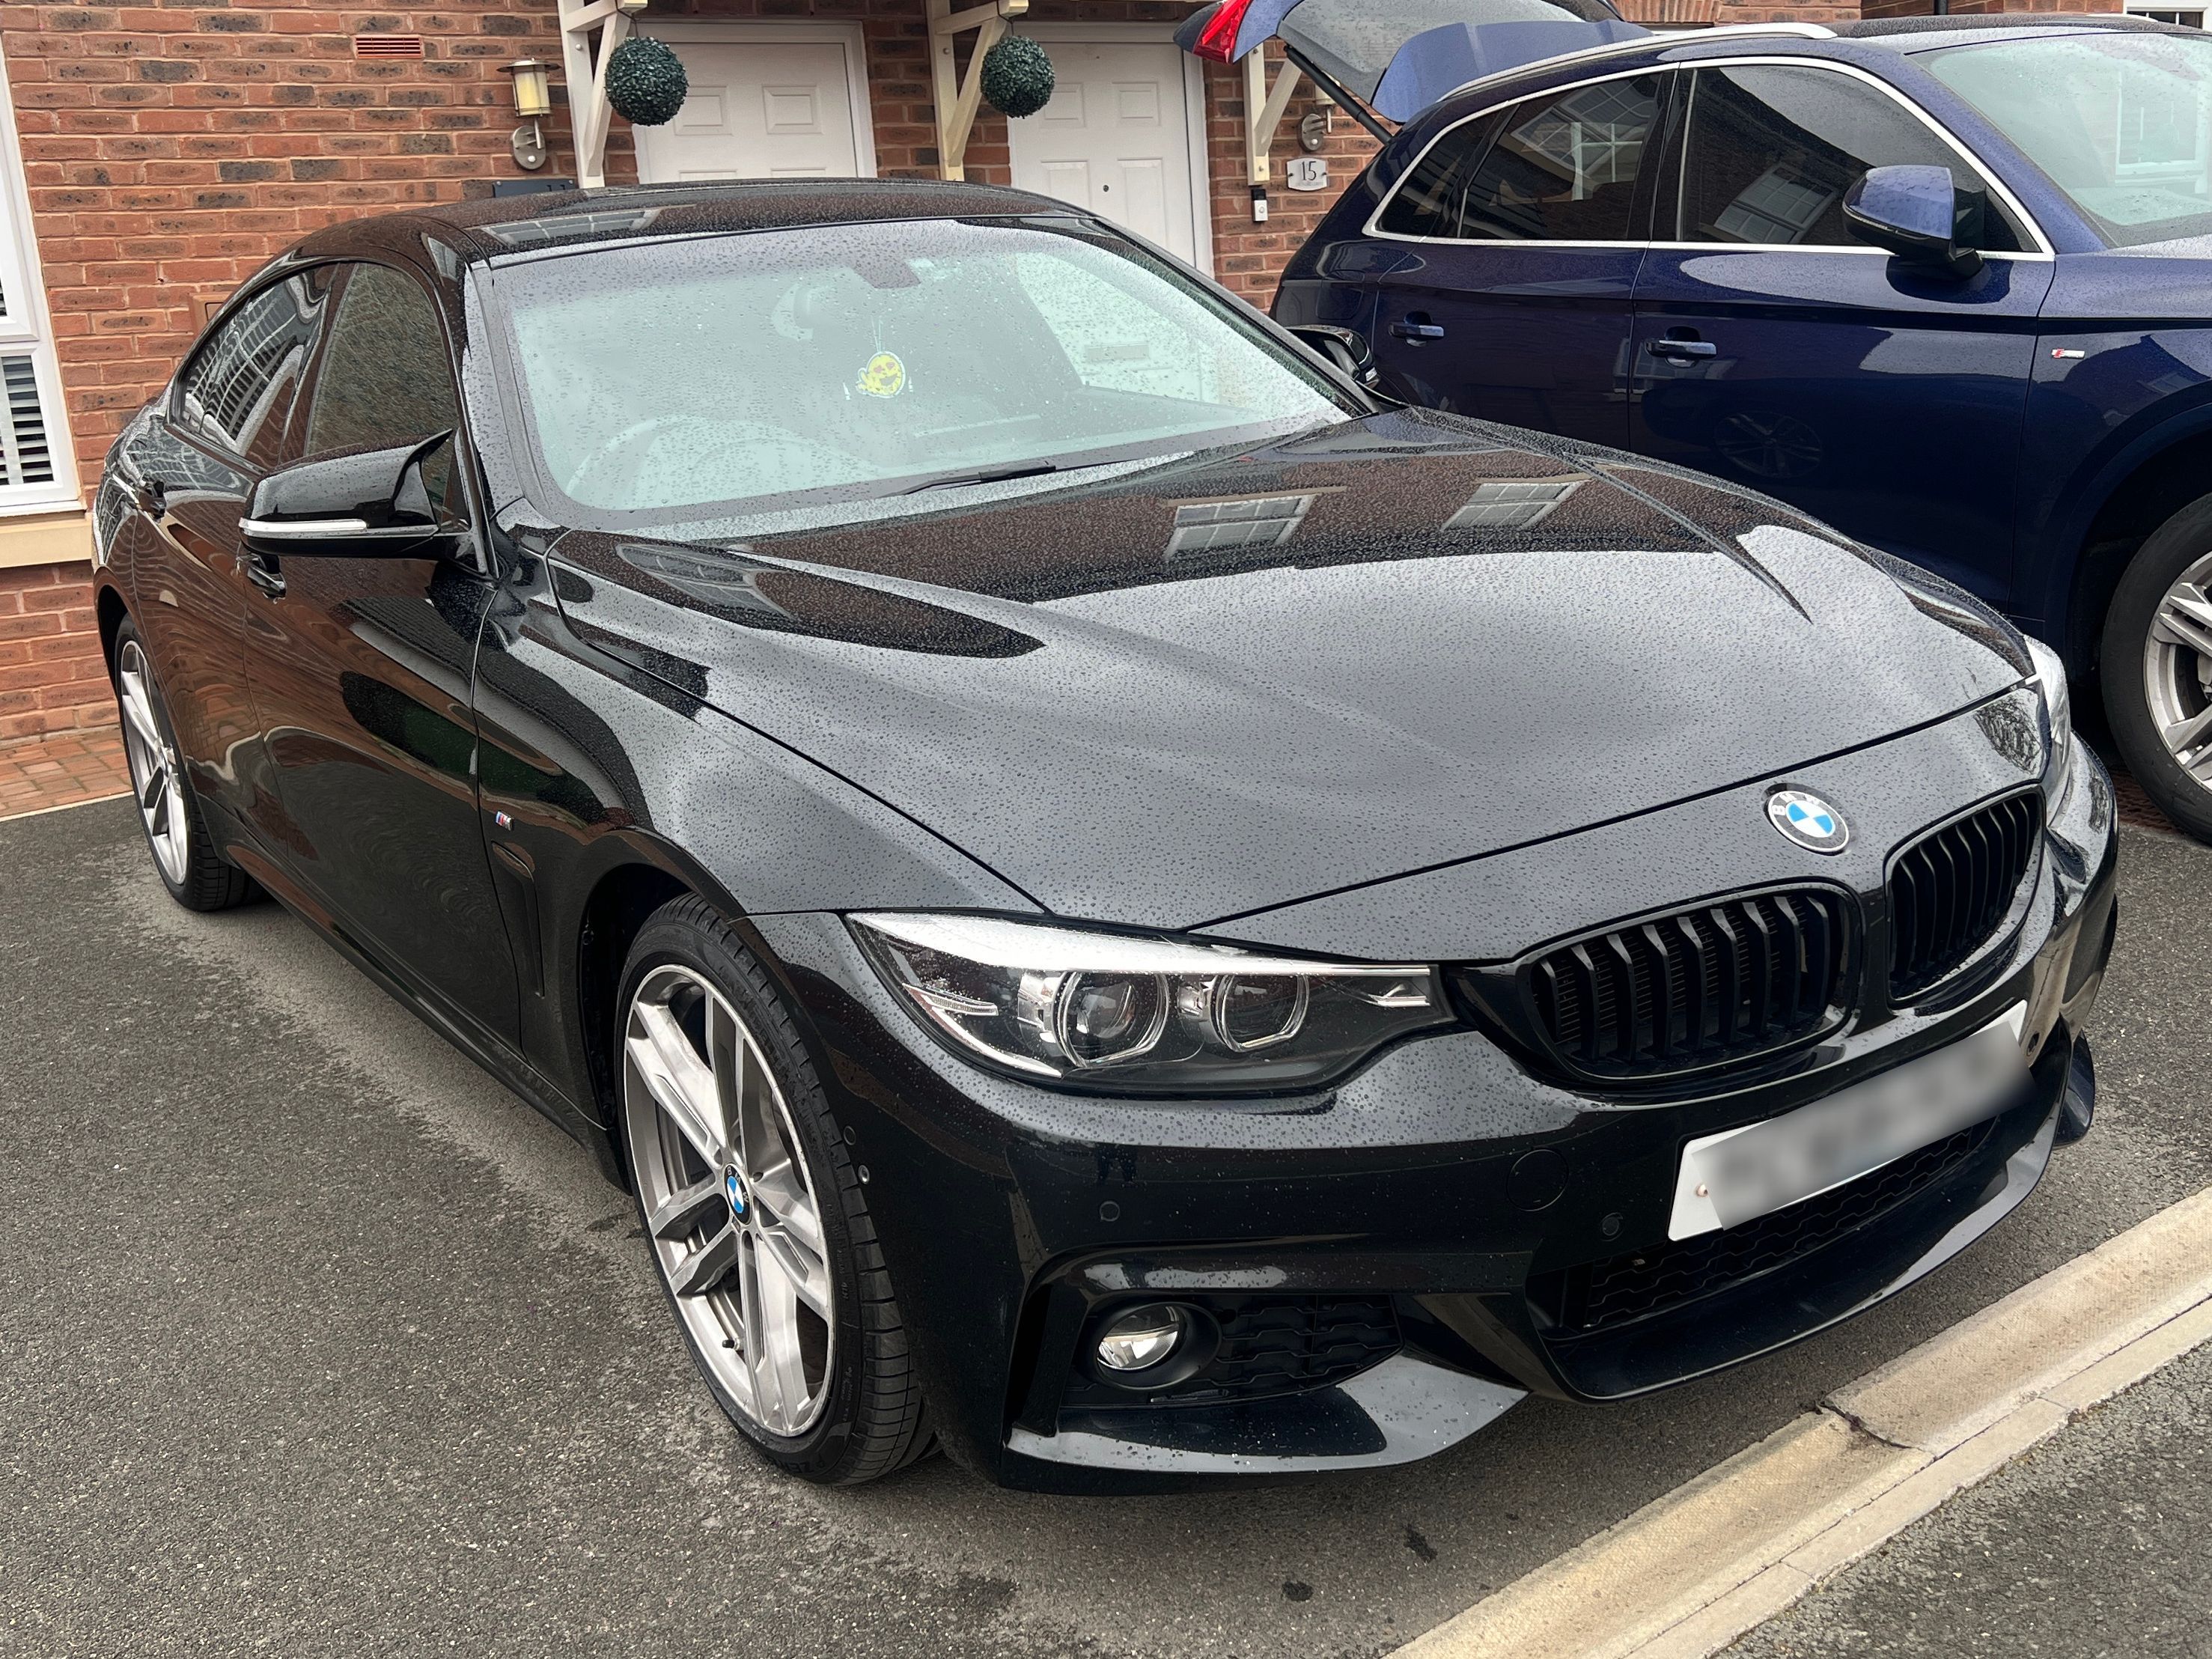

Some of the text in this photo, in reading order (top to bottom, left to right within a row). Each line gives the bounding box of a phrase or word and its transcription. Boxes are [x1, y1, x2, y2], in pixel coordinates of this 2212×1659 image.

[1301, 160, 1317, 181] 15
[1772, 791, 1821, 816] BMW
[727, 1166, 749, 1203] BMW
